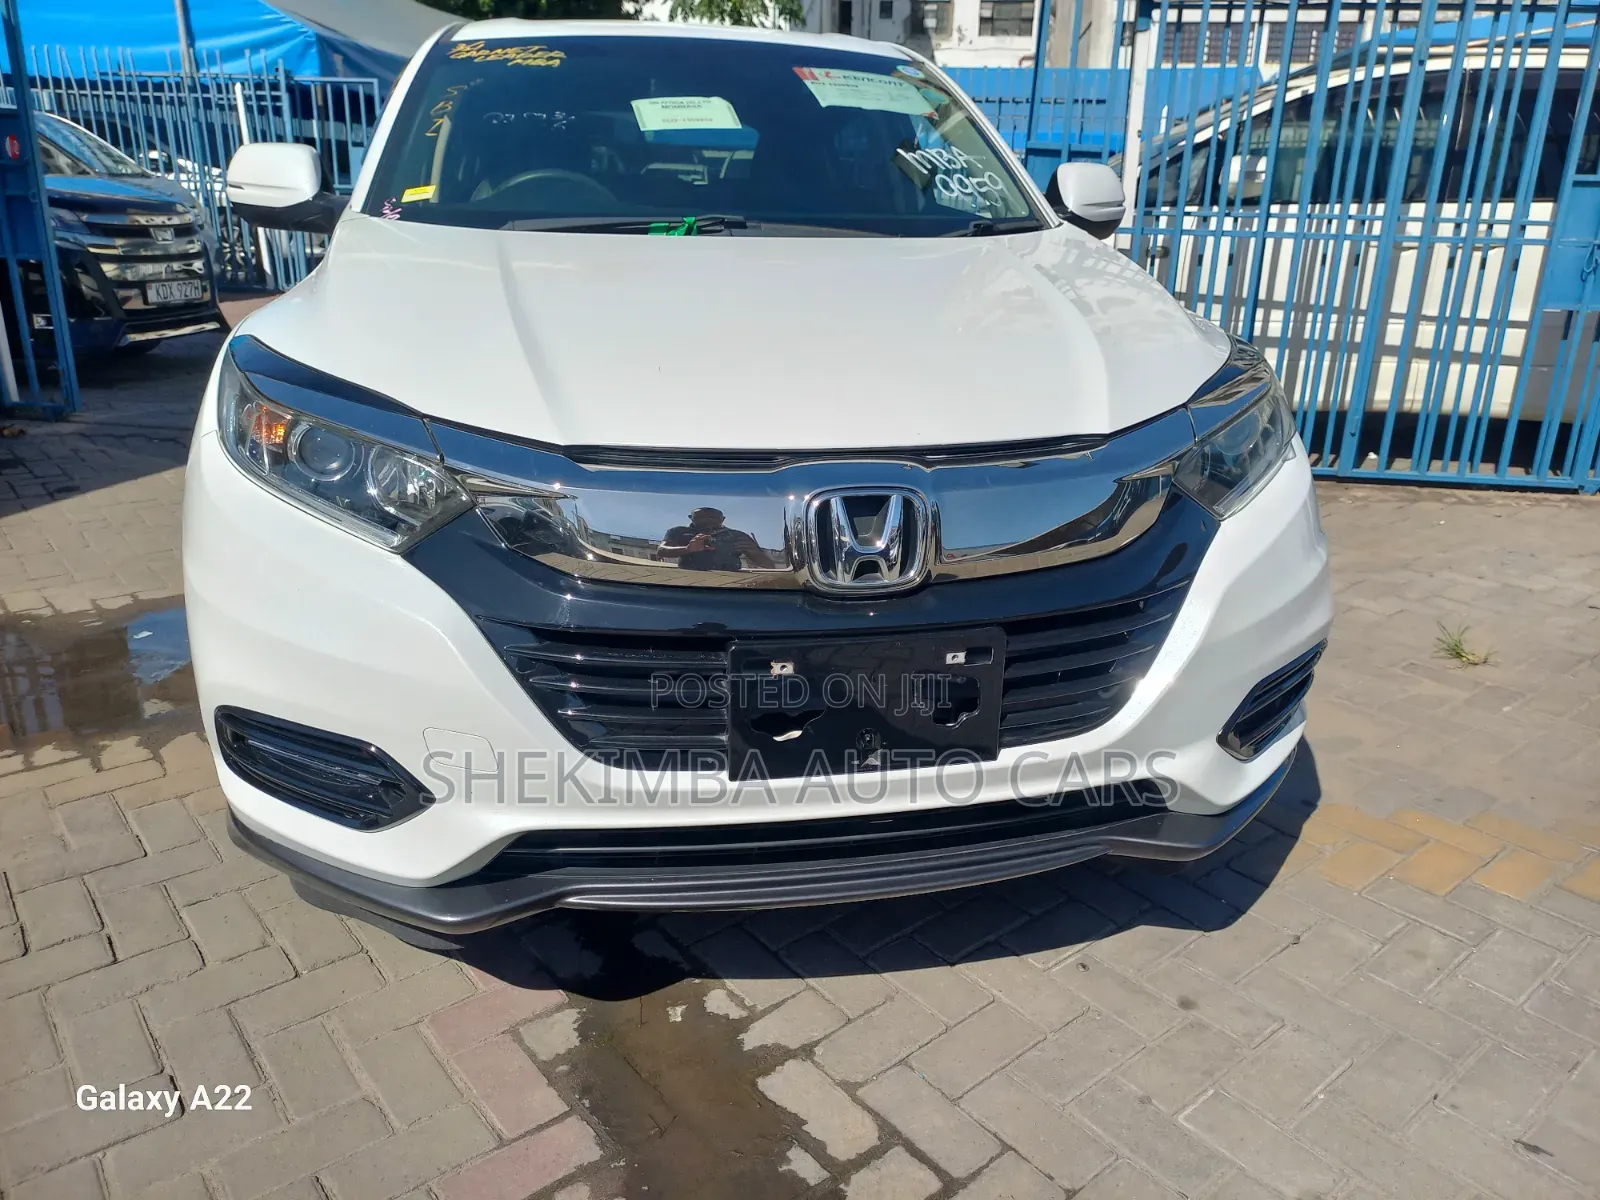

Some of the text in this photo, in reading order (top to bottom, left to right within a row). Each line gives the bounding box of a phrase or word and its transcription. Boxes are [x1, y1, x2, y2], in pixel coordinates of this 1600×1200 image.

[896, 146, 984, 174] MBA
[155, 281, 201, 301] KDX 927H
